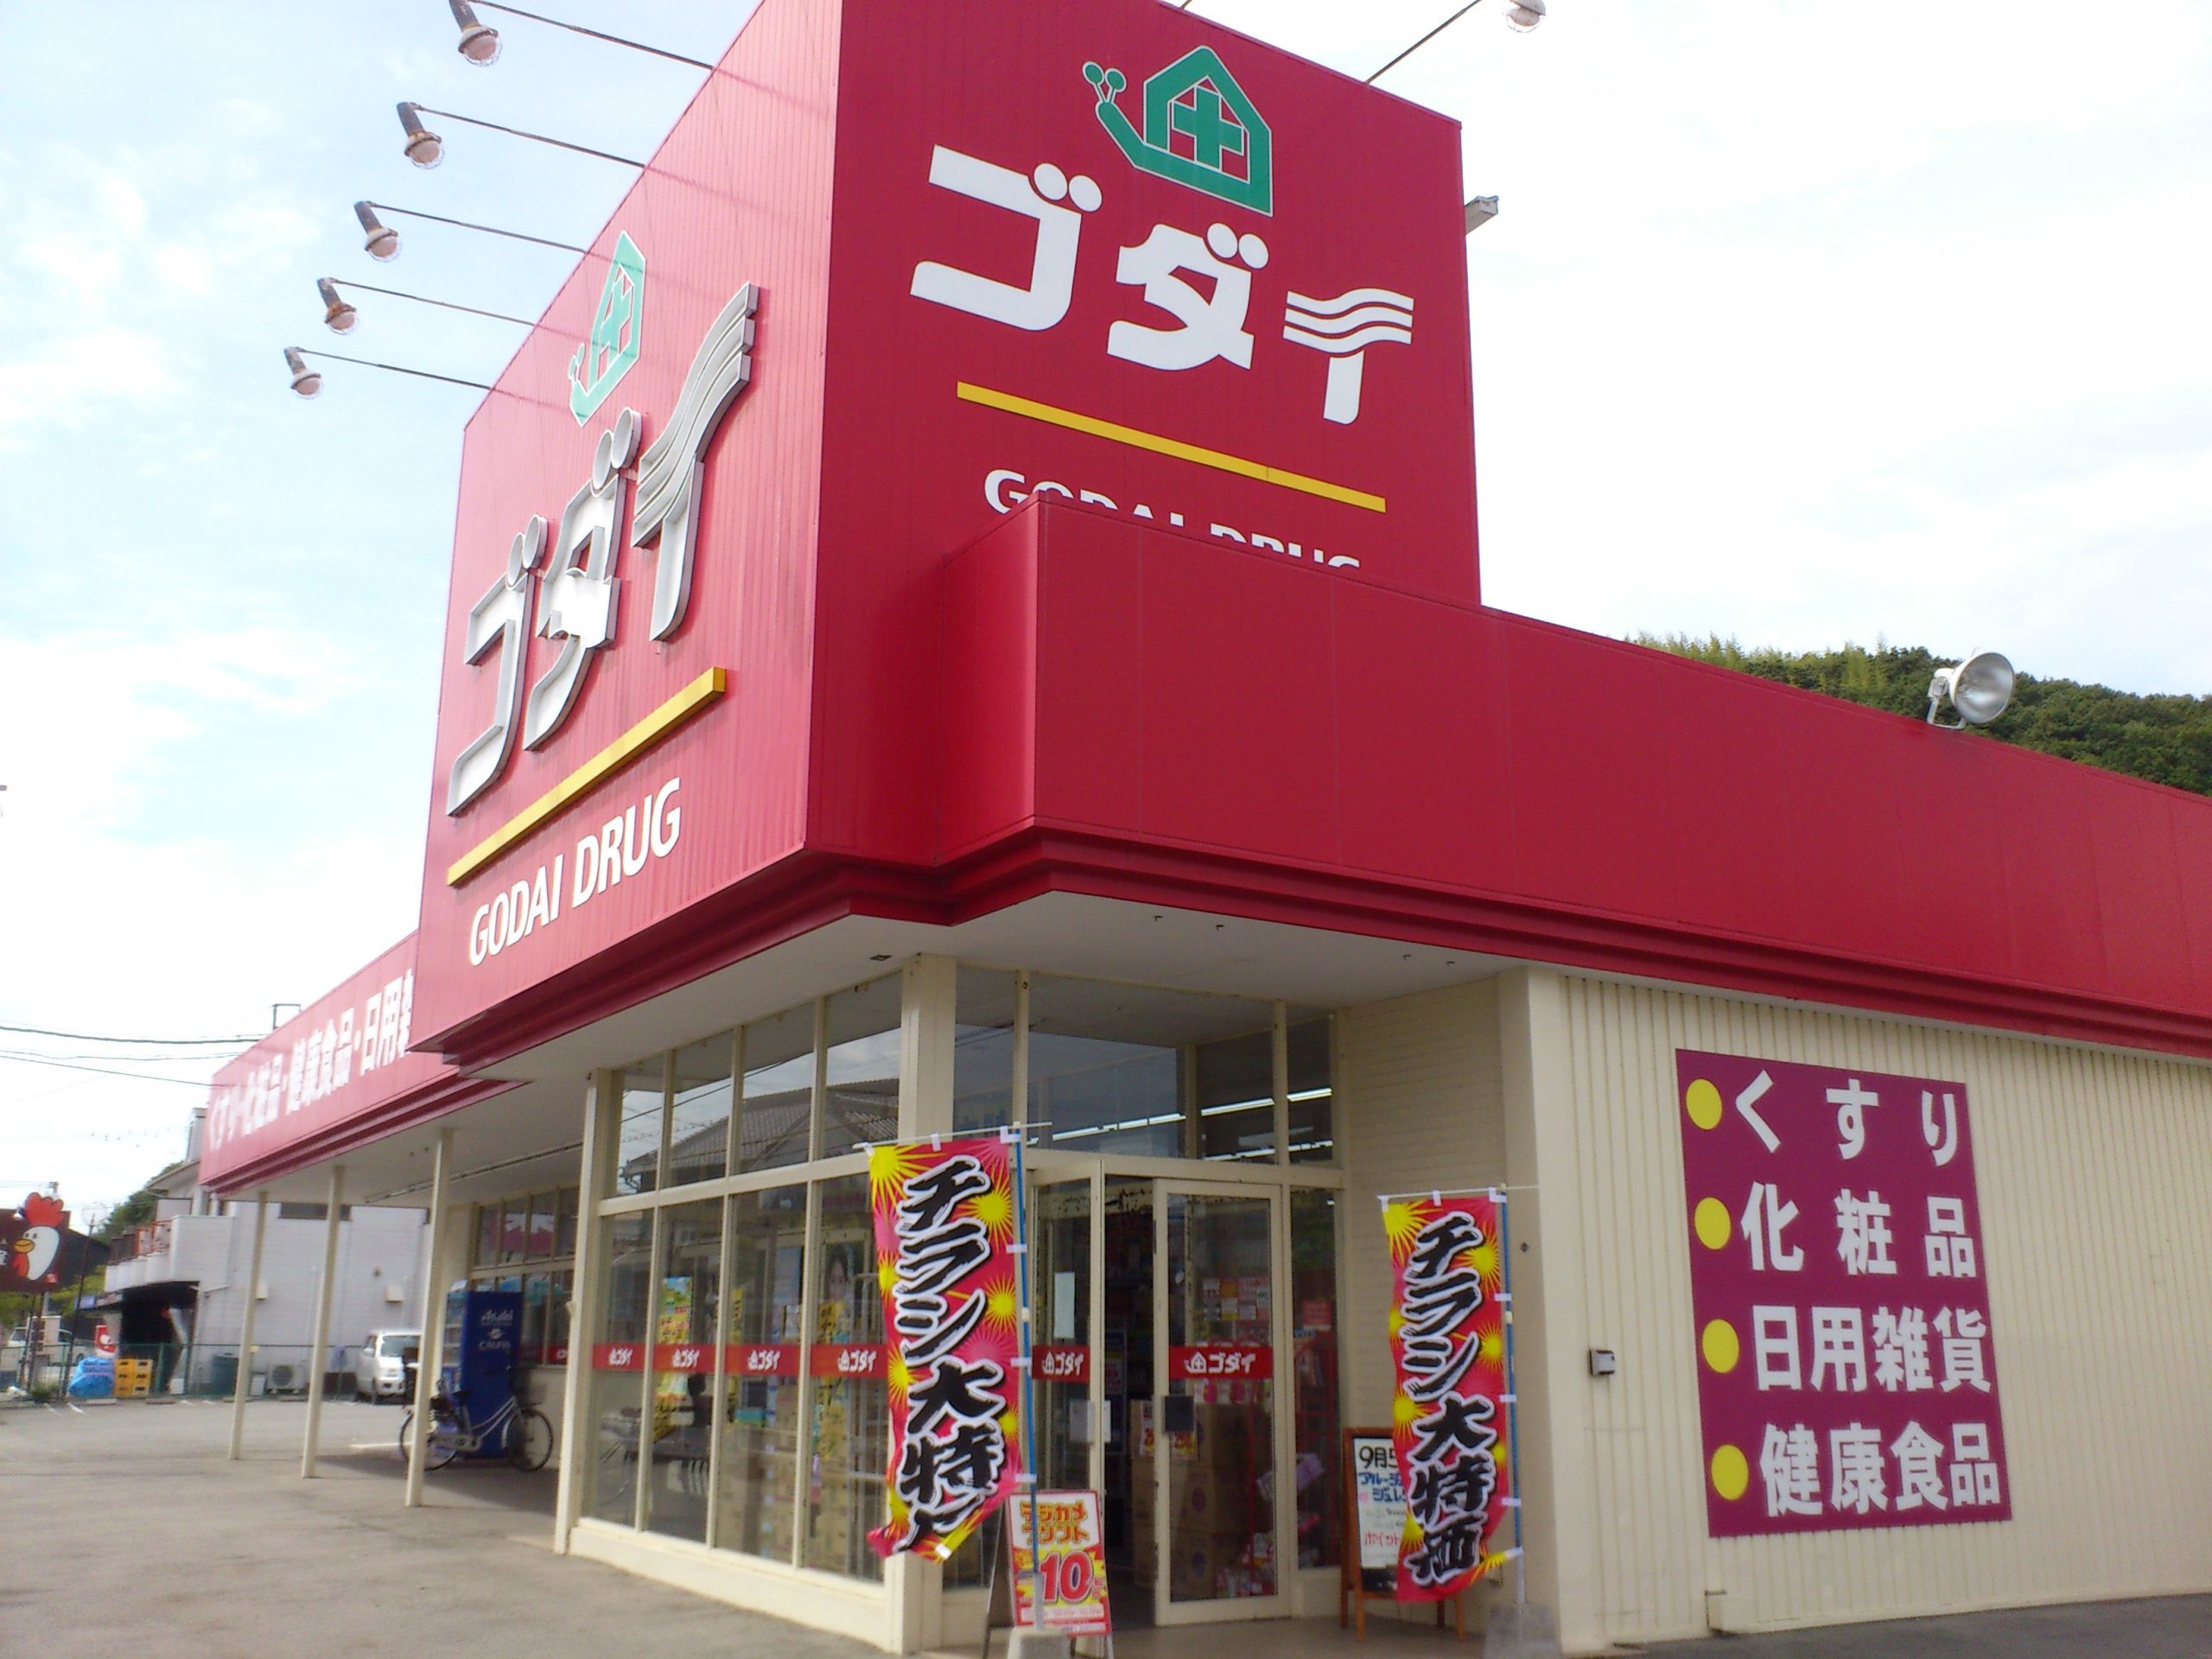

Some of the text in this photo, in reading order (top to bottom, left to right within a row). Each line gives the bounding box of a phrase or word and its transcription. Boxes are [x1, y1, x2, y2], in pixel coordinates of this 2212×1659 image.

[909, 144, 1415, 425] ゴダイ
[447, 282, 759, 817] ゴダイ
[469, 777, 681, 966] GODAI DRUG
[1735, 1069, 1959, 1166] くすり
[1740, 1180, 1977, 1278] 化粧品
[849, 1351, 877, 1372] ゴダイ
[1054, 1352, 1084, 1375] ゴダイ
[1209, 1352, 1255, 1374] ゴダイ
[1751, 1305, 1992, 1394] 日用雑貨
[1401, 1211, 1499, 1586] チラシ大特価
[1758, 1421, 2002, 1518] 健康食品
[1039, 1551, 1093, 1604] 10
